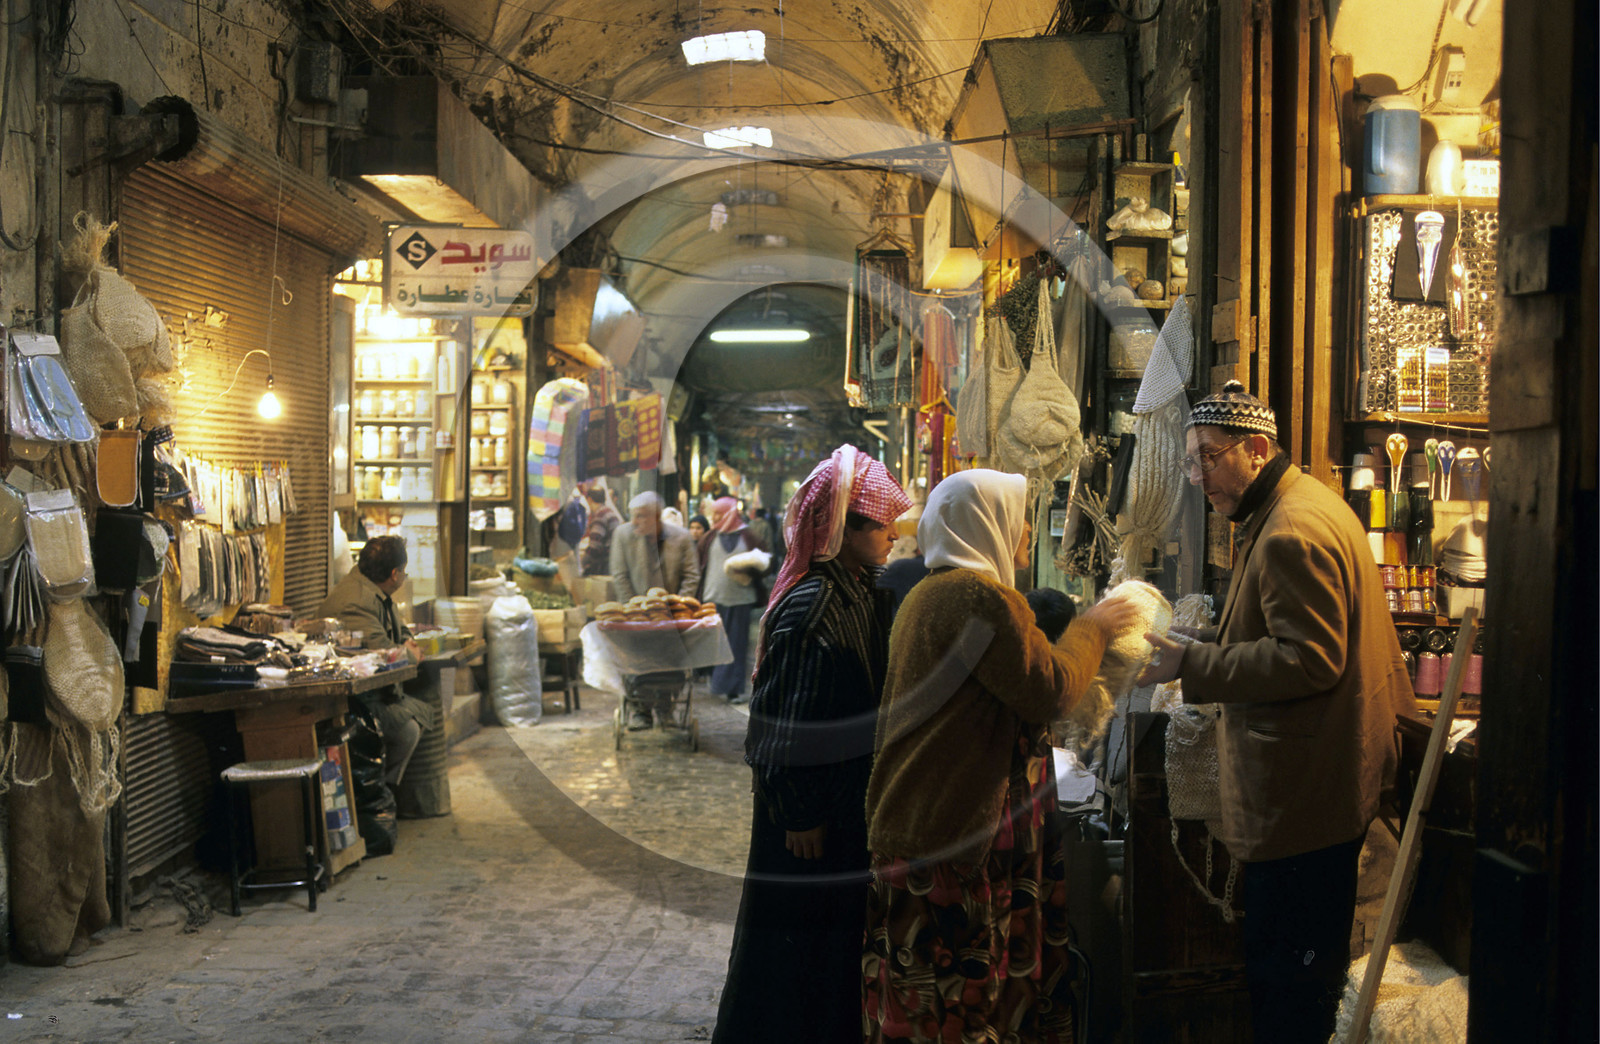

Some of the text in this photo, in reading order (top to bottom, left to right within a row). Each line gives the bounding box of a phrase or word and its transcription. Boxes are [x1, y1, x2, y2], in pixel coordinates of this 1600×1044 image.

[407, 240, 426, 261] S
[441, 240, 531, 273] سويد
[397, 284, 532, 309] تجارة عطارة
